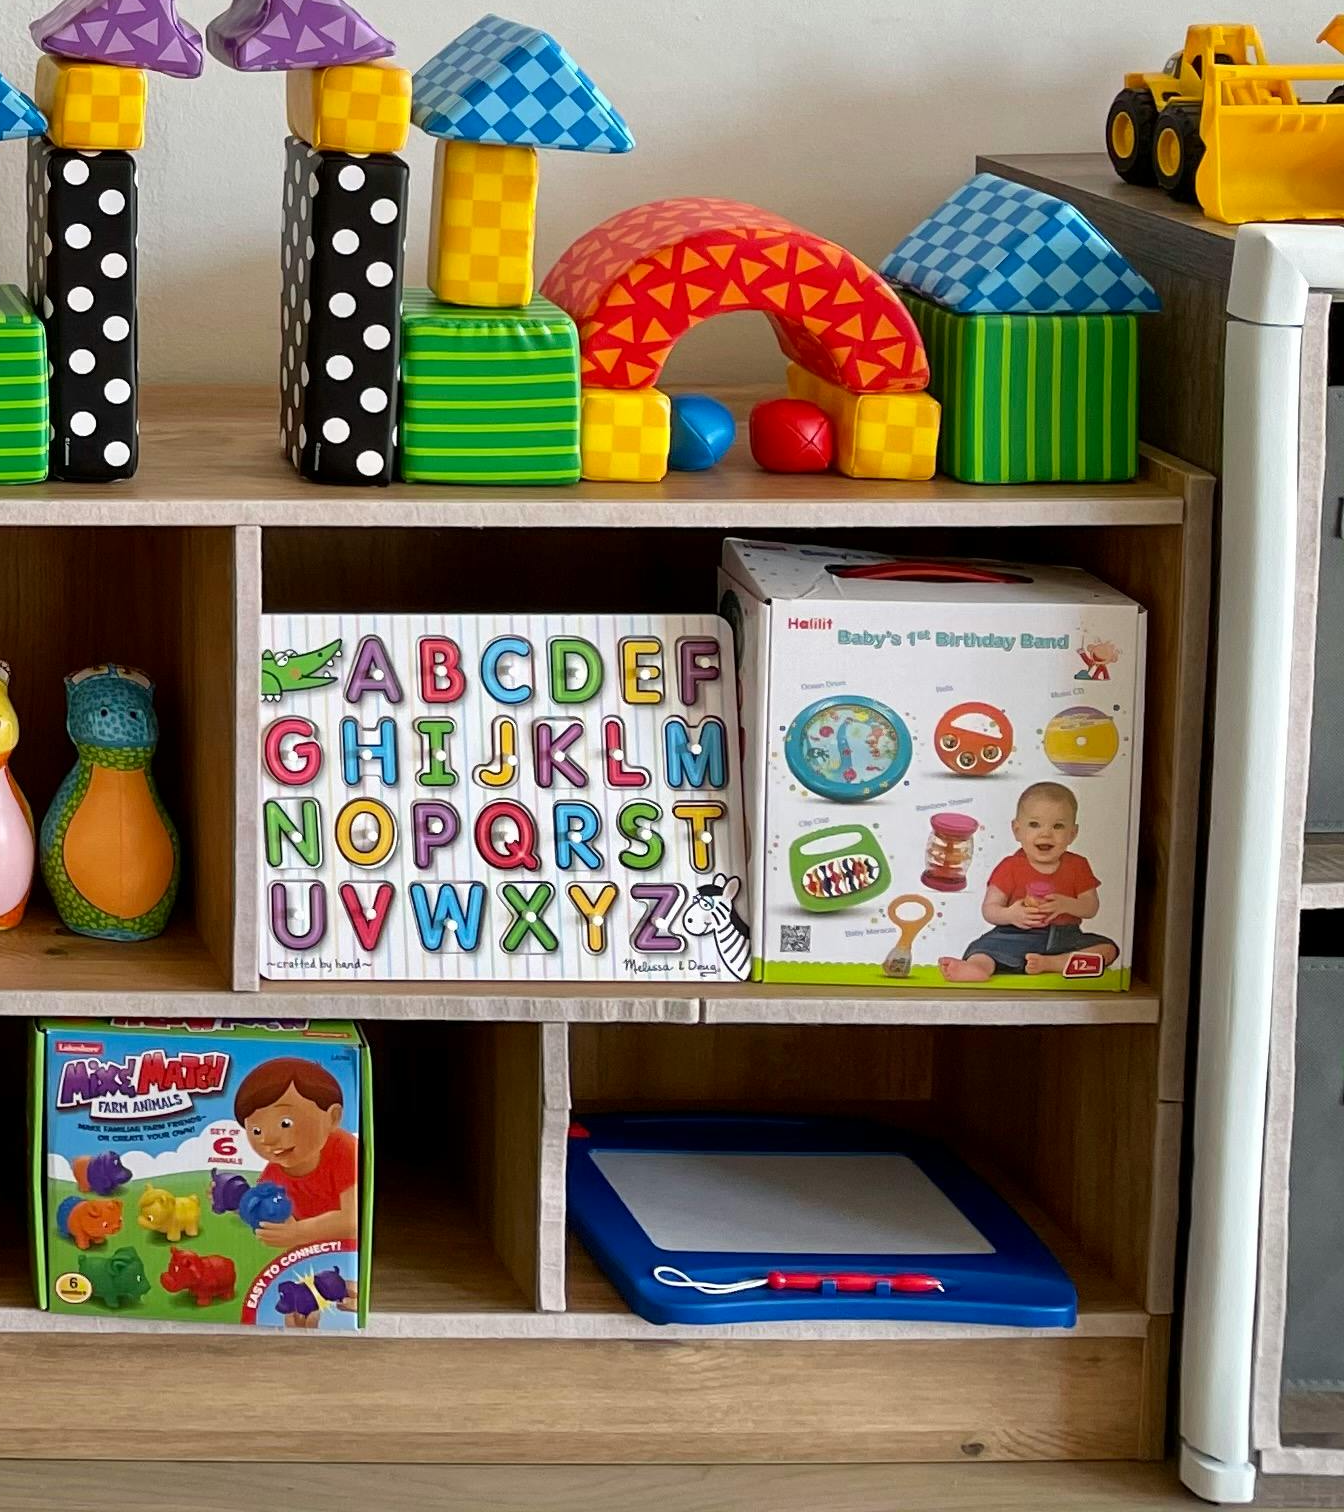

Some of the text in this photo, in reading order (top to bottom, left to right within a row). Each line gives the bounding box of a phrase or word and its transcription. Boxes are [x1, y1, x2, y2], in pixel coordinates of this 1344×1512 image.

[788, 617, 833, 630] Halilit
[837, 629, 1070, 652] Baby's 1st Birthday Band
[319, 957, 333, 972] by
[624, 958, 672, 974] Melissa
[1072, 960, 1088, 970] 12
[98, 1094, 183, 1114] FARM ANIMALS
[213, 1137, 237, 1156] 6
[247, 1241, 342, 1308] EASY TO CONNECT!
[69, 1277, 78, 1289] 6
